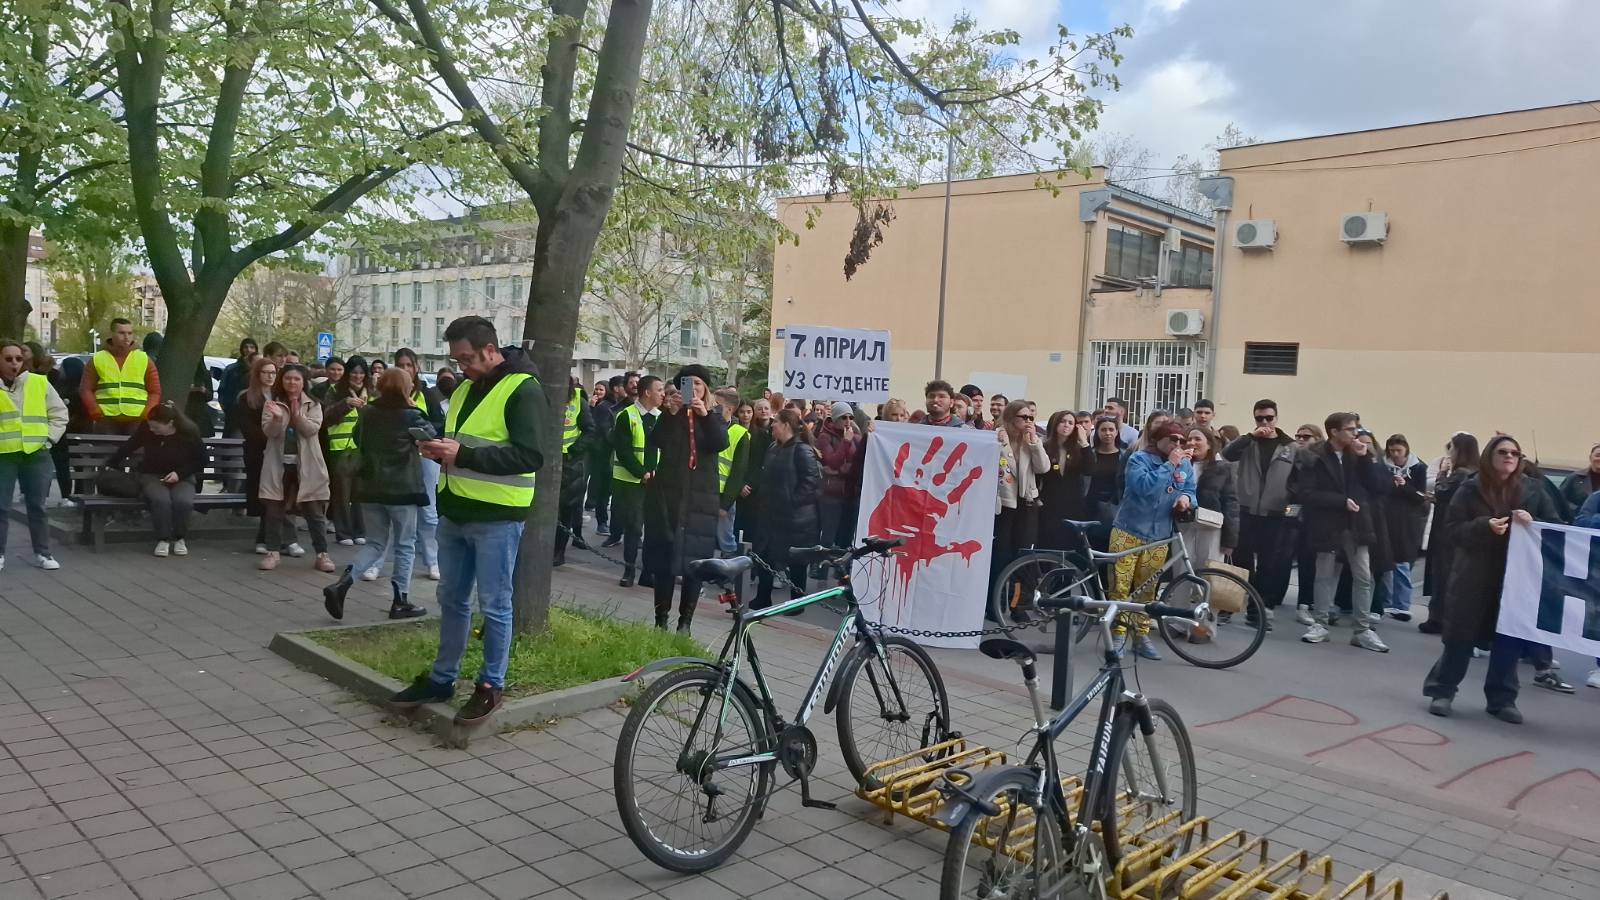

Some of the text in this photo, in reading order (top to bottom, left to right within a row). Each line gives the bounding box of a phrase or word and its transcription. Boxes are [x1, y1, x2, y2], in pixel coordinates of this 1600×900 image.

[790, 333, 807, 358] 7.
[814, 336, 886, 362] АПРИЛ
[785, 370, 890, 395] УЗ СТУДЕНТЕ
[1096, 721, 1114, 774] TAIFUN
